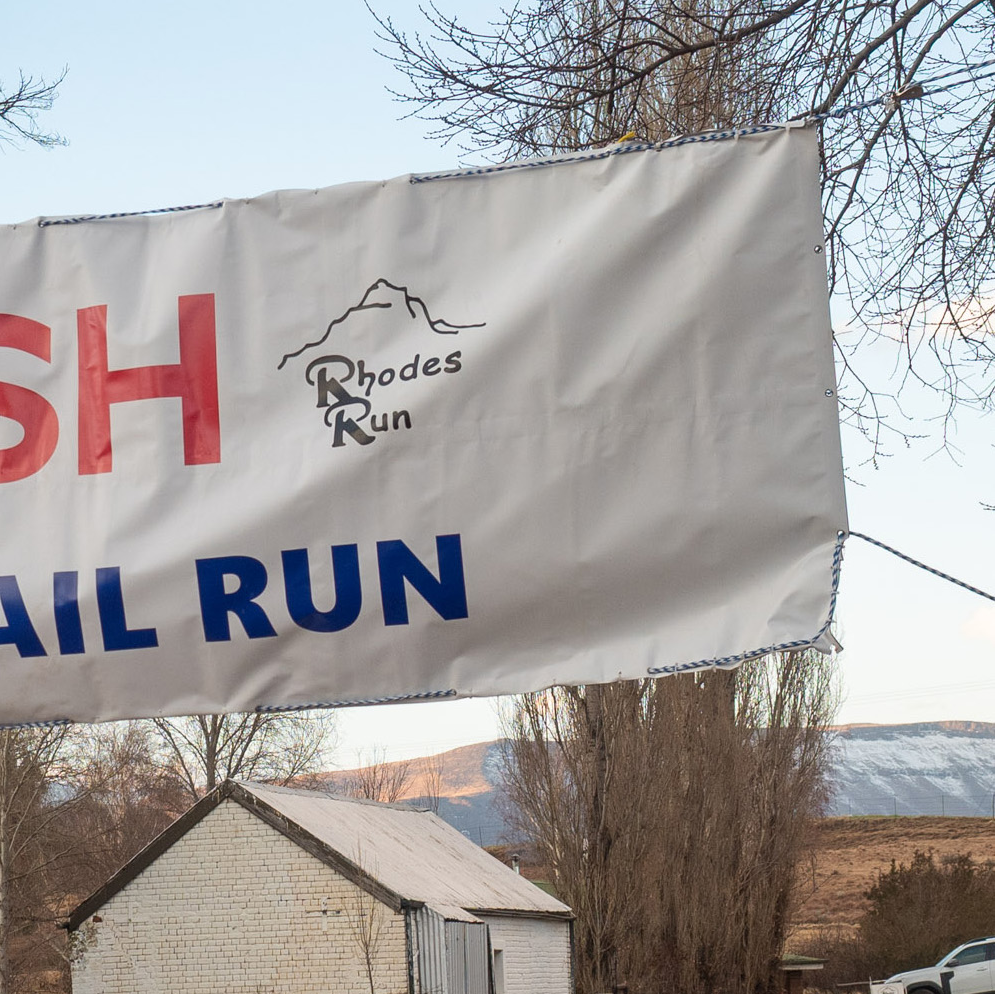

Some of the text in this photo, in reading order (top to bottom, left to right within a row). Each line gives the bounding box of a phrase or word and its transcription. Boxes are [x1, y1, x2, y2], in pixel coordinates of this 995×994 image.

[305, 350, 462, 408] Rhodes
[323, 396, 412, 448] Run
[196, 535, 467, 642] RUN
